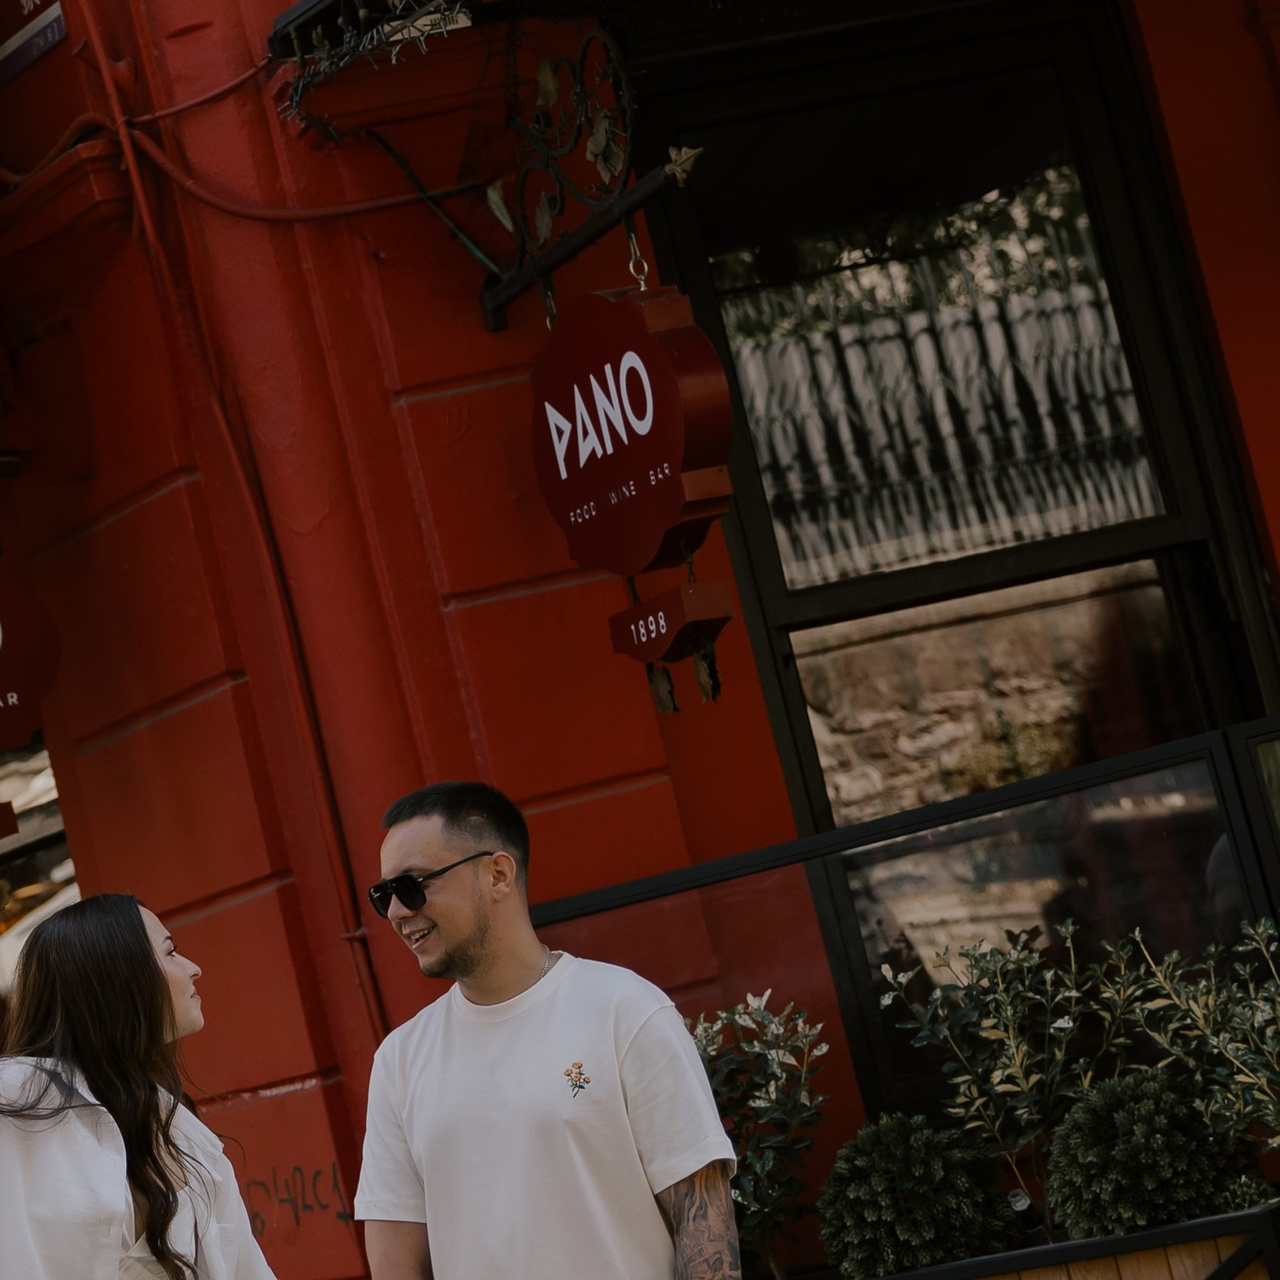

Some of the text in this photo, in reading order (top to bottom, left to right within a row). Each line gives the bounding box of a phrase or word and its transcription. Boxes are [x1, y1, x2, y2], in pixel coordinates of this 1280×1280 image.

[544, 350, 654, 480] PANO
[569, 462, 672, 525] FOOD WINE BAR
[630, 611, 667, 645] 1898
